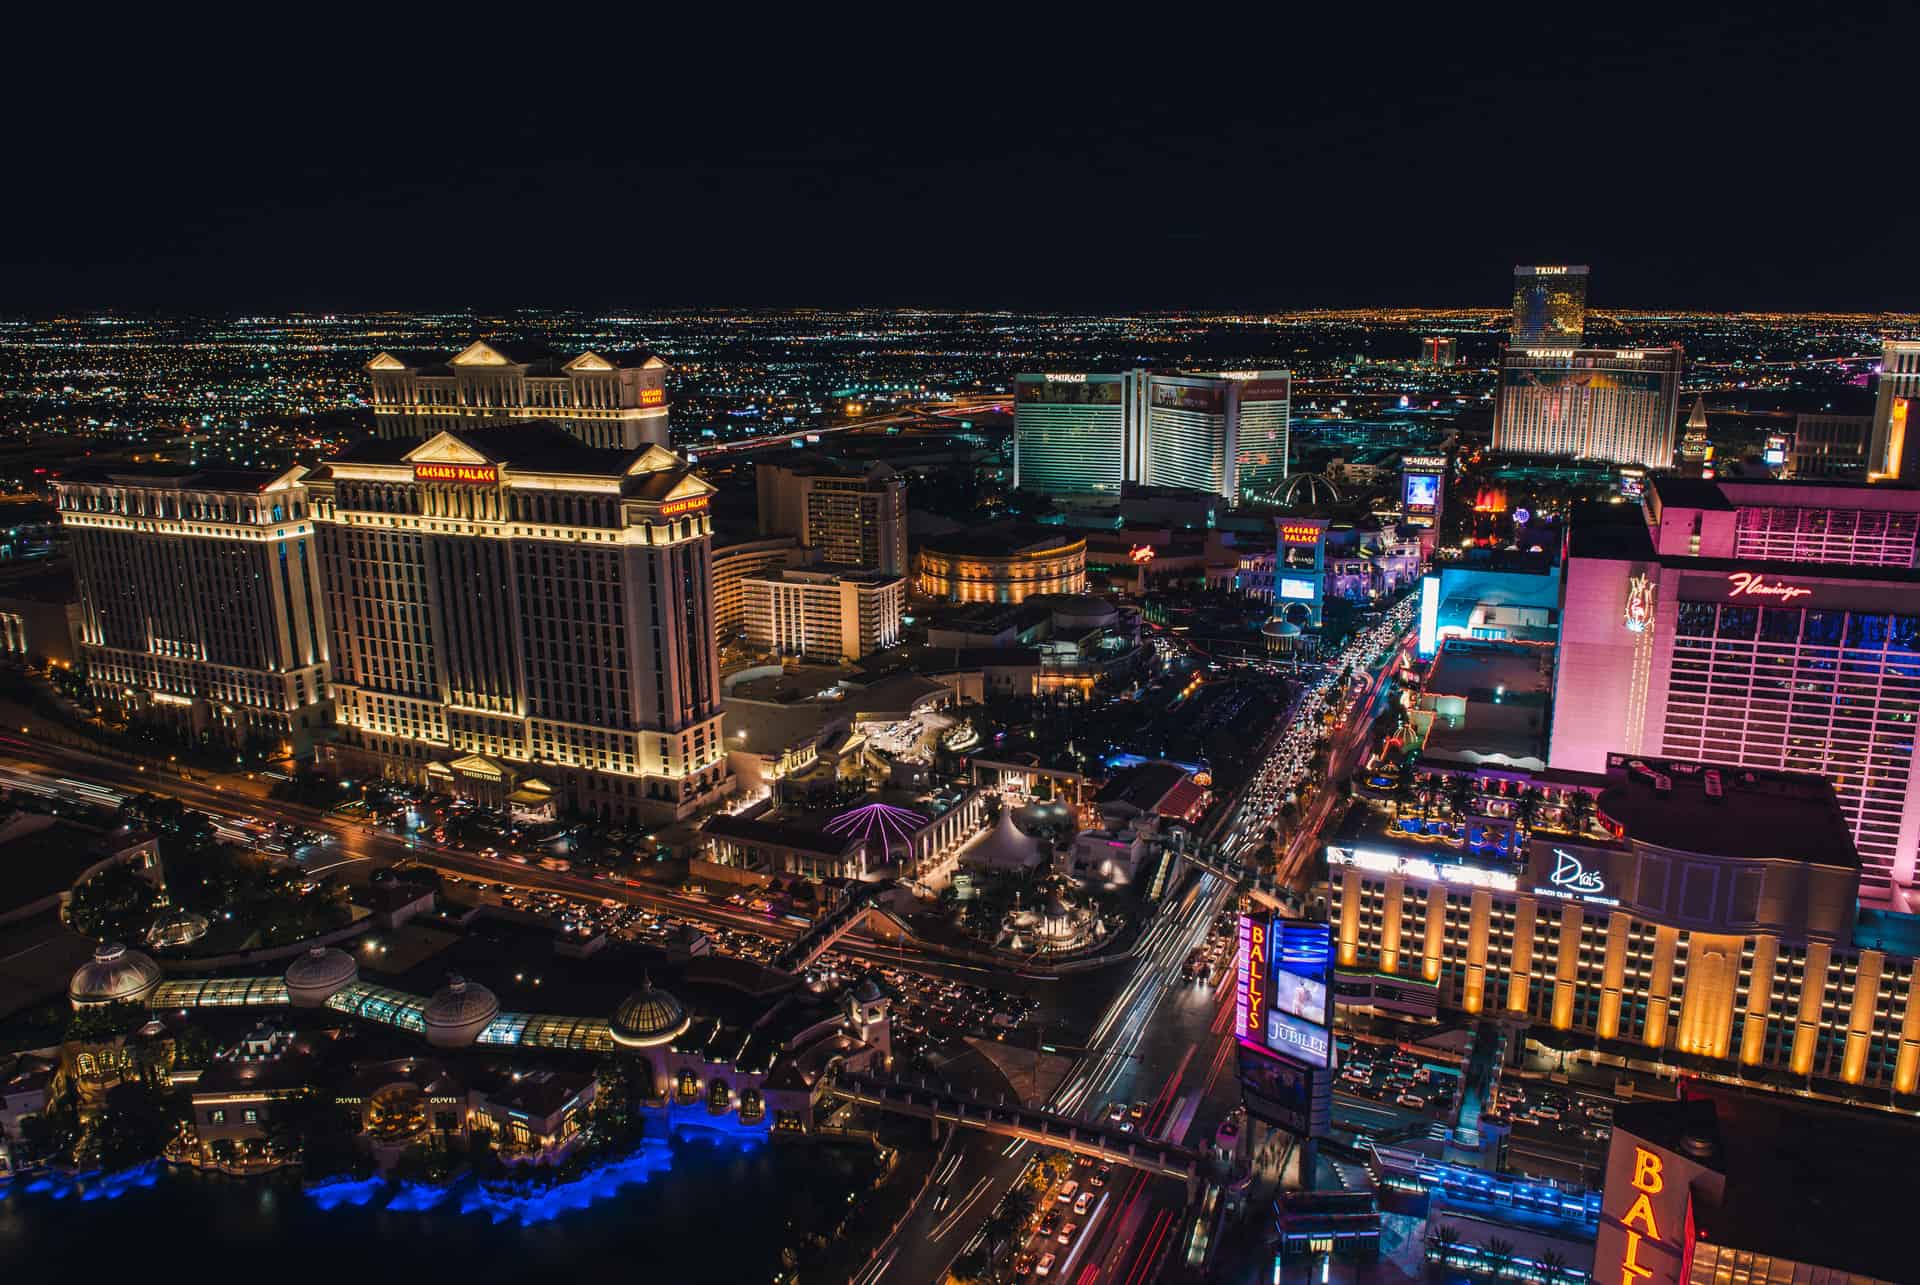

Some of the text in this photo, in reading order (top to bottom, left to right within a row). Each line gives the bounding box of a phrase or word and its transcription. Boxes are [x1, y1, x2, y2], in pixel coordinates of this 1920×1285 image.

[1535, 266, 1568, 275] TRUMP
[1527, 349, 1645, 360] TREASURE ISLAND
[416, 466, 495, 481] CAESARS PALACE
[662, 495, 708, 515] CAESARS PALACE
[1283, 526, 1319, 535] CAESARS
[1284, 534, 1318, 543] PALACE
[1728, 572, 1812, 601] Flamingo
[1534, 887, 1556, 898] BEACH
[1556, 890, 1574, 900] CLUB
[1268, 1021, 1328, 1053] JUBILEE
